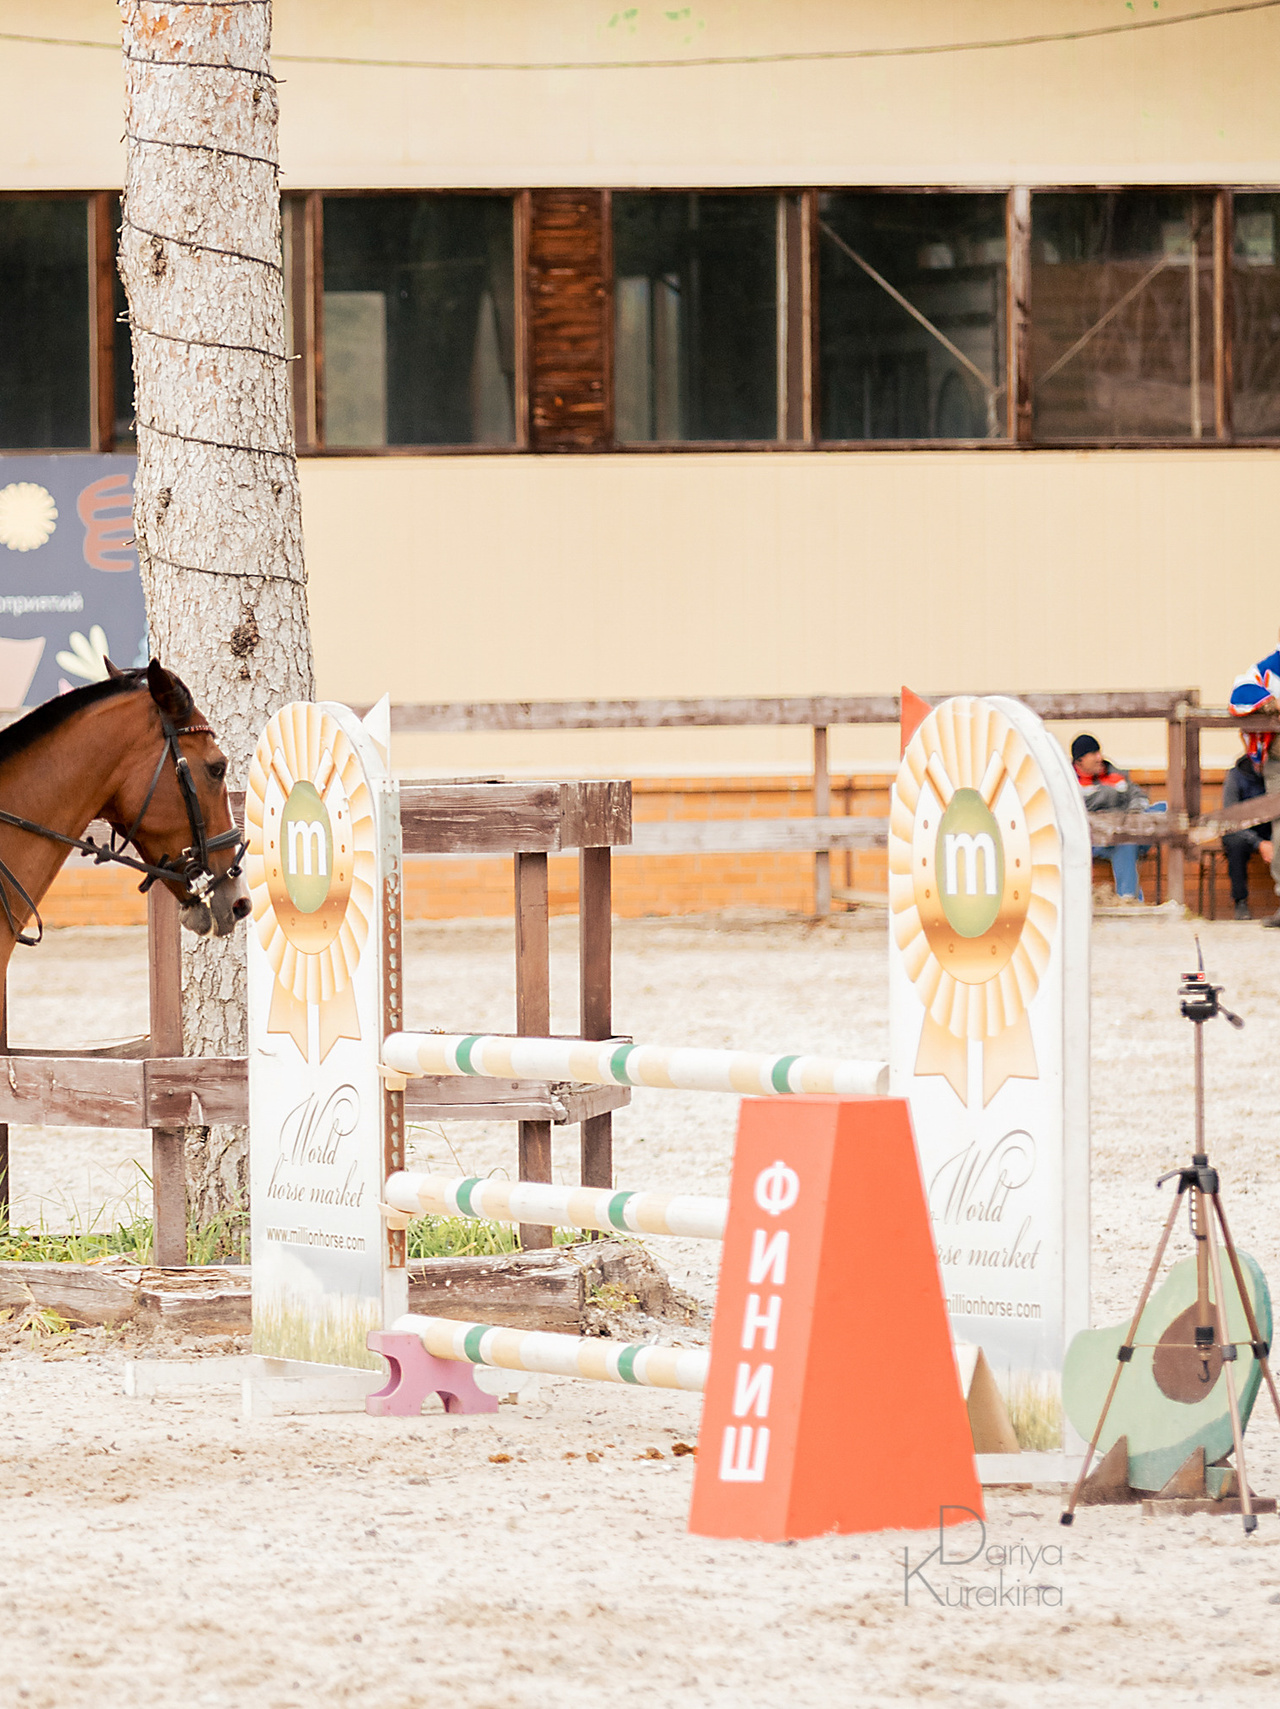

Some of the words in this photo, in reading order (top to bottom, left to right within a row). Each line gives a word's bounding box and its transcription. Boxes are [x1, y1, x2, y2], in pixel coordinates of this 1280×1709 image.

[287, 820, 328, 876] m
[944, 832, 998, 895] m
[279, 1083, 360, 1165] World
[267, 1153, 306, 1201] horse
[310, 1160, 365, 1207] market
[928, 1129, 1036, 1224] World
[267, 1226, 366, 1251] www.millionhorse.com
[936, 1244, 962, 1265] rse
[968, 1215, 1042, 1269] market
[719, 1160, 800, 1482] ФИНИШ
[945, 1294, 1042, 1318] illionhorse.com
